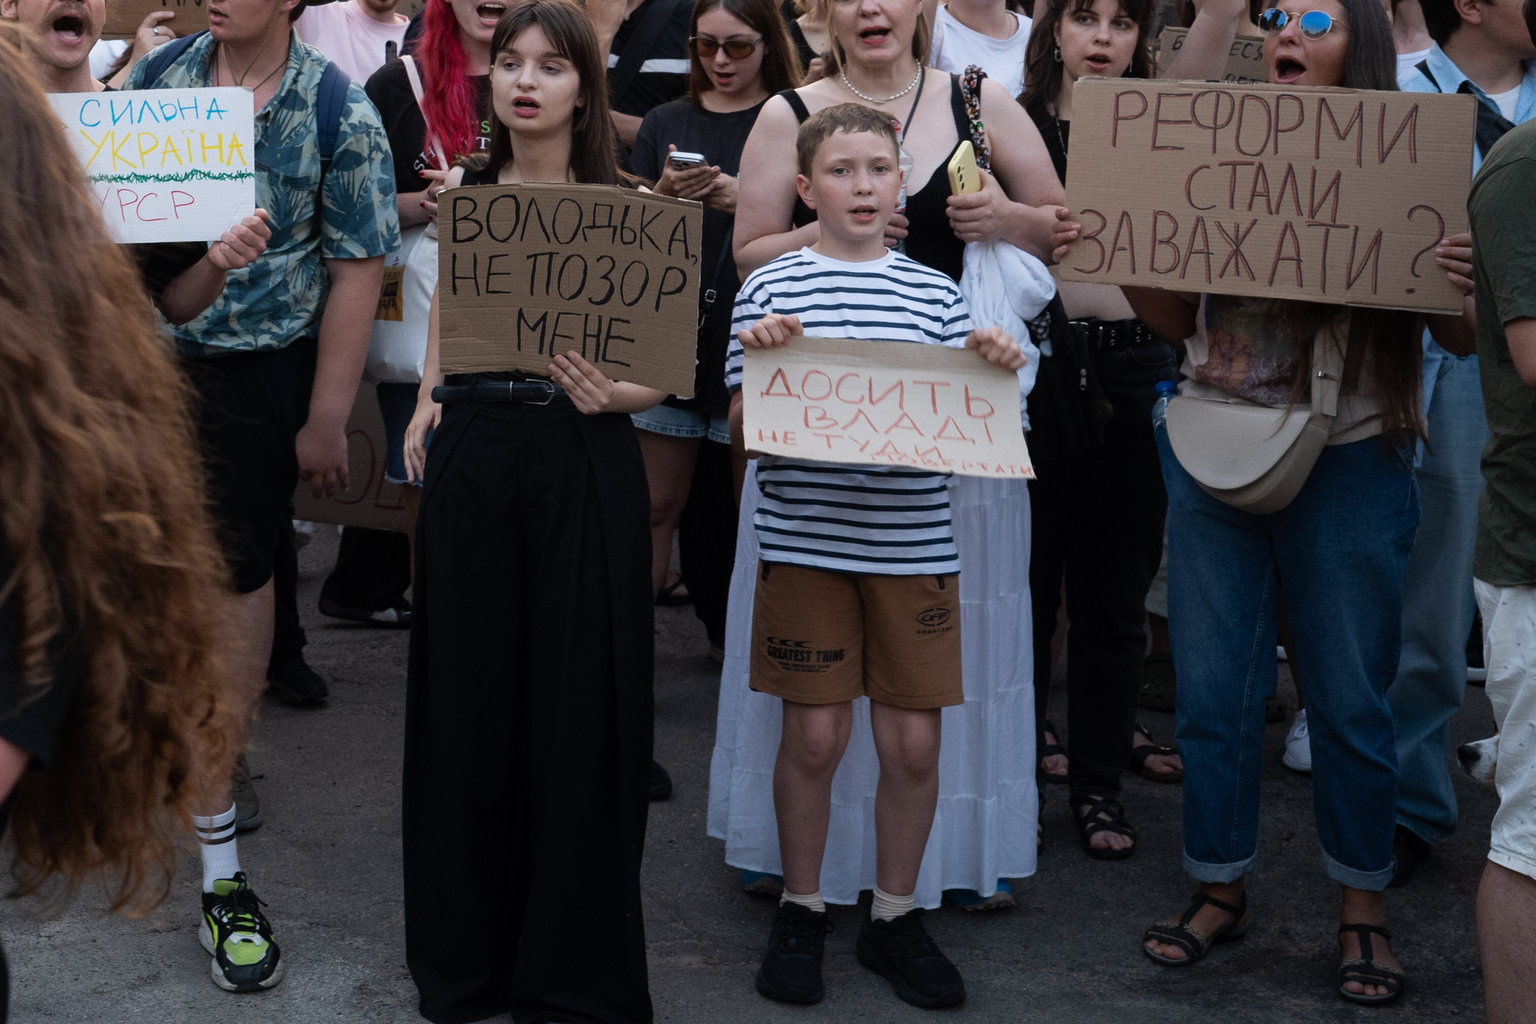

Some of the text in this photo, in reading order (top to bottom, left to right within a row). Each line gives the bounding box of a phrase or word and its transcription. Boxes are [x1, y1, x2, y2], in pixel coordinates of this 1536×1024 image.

[79, 95, 229, 127] СИЛЬНА
[1111, 90, 1419, 168] РЕФОРМИ
[80, 129, 247, 171] УКРАЇНА
[1184, 160, 1342, 223] СТАЛИ
[452, 194, 699, 266] ВОЛОДЬКА,
[452, 251, 687, 312] НЕ ПОЗОР
[517, 307, 635, 368] МЕНЕ
[760, 367, 996, 419] ДОСИТЬ
[758, 429, 798, 446] НЕ
[767, 645, 845, 664] GREATEST THING
